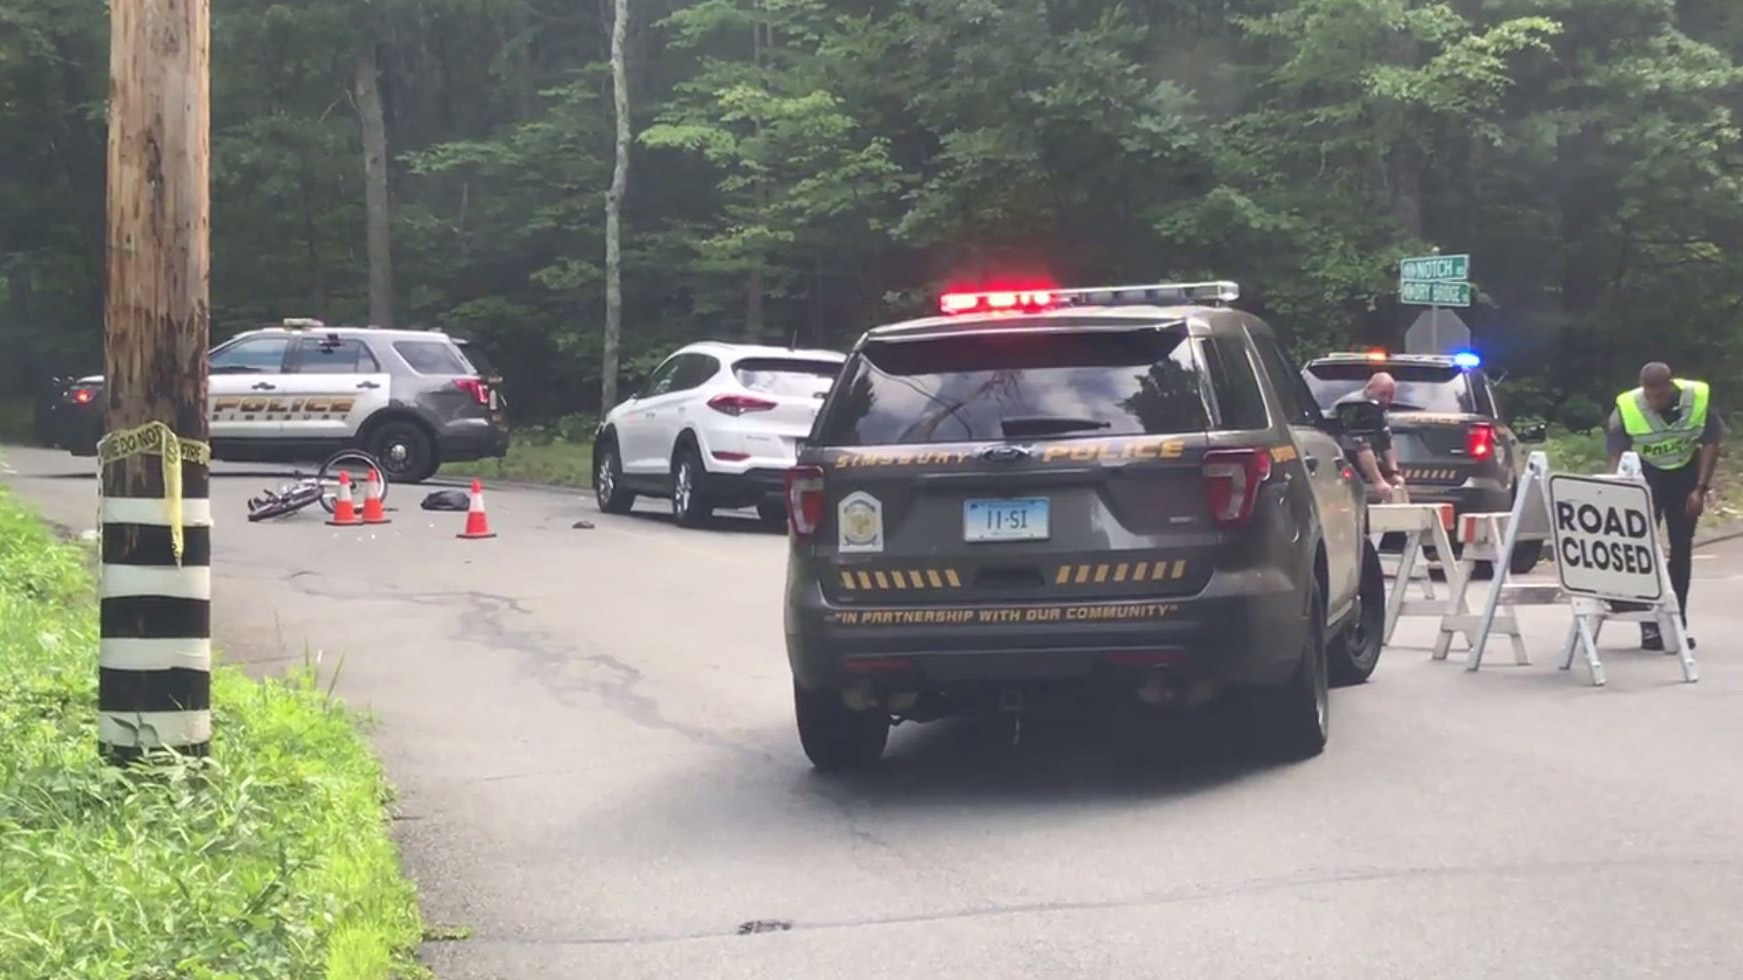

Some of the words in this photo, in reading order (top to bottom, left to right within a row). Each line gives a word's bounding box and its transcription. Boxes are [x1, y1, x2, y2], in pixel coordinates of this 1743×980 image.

[1417, 260, 1453, 278] NOTCH
[213, 398, 356, 412] POLICE
[1042, 439, 1185, 462] POLICE
[1556, 501, 1647, 539] ROAD
[1562, 536, 1652, 575] CLOSED
[861, 609, 974, 624] PARTNERSHIP
[979, 608, 1020, 622] WITH
[1026, 608, 1061, 621] OUR
